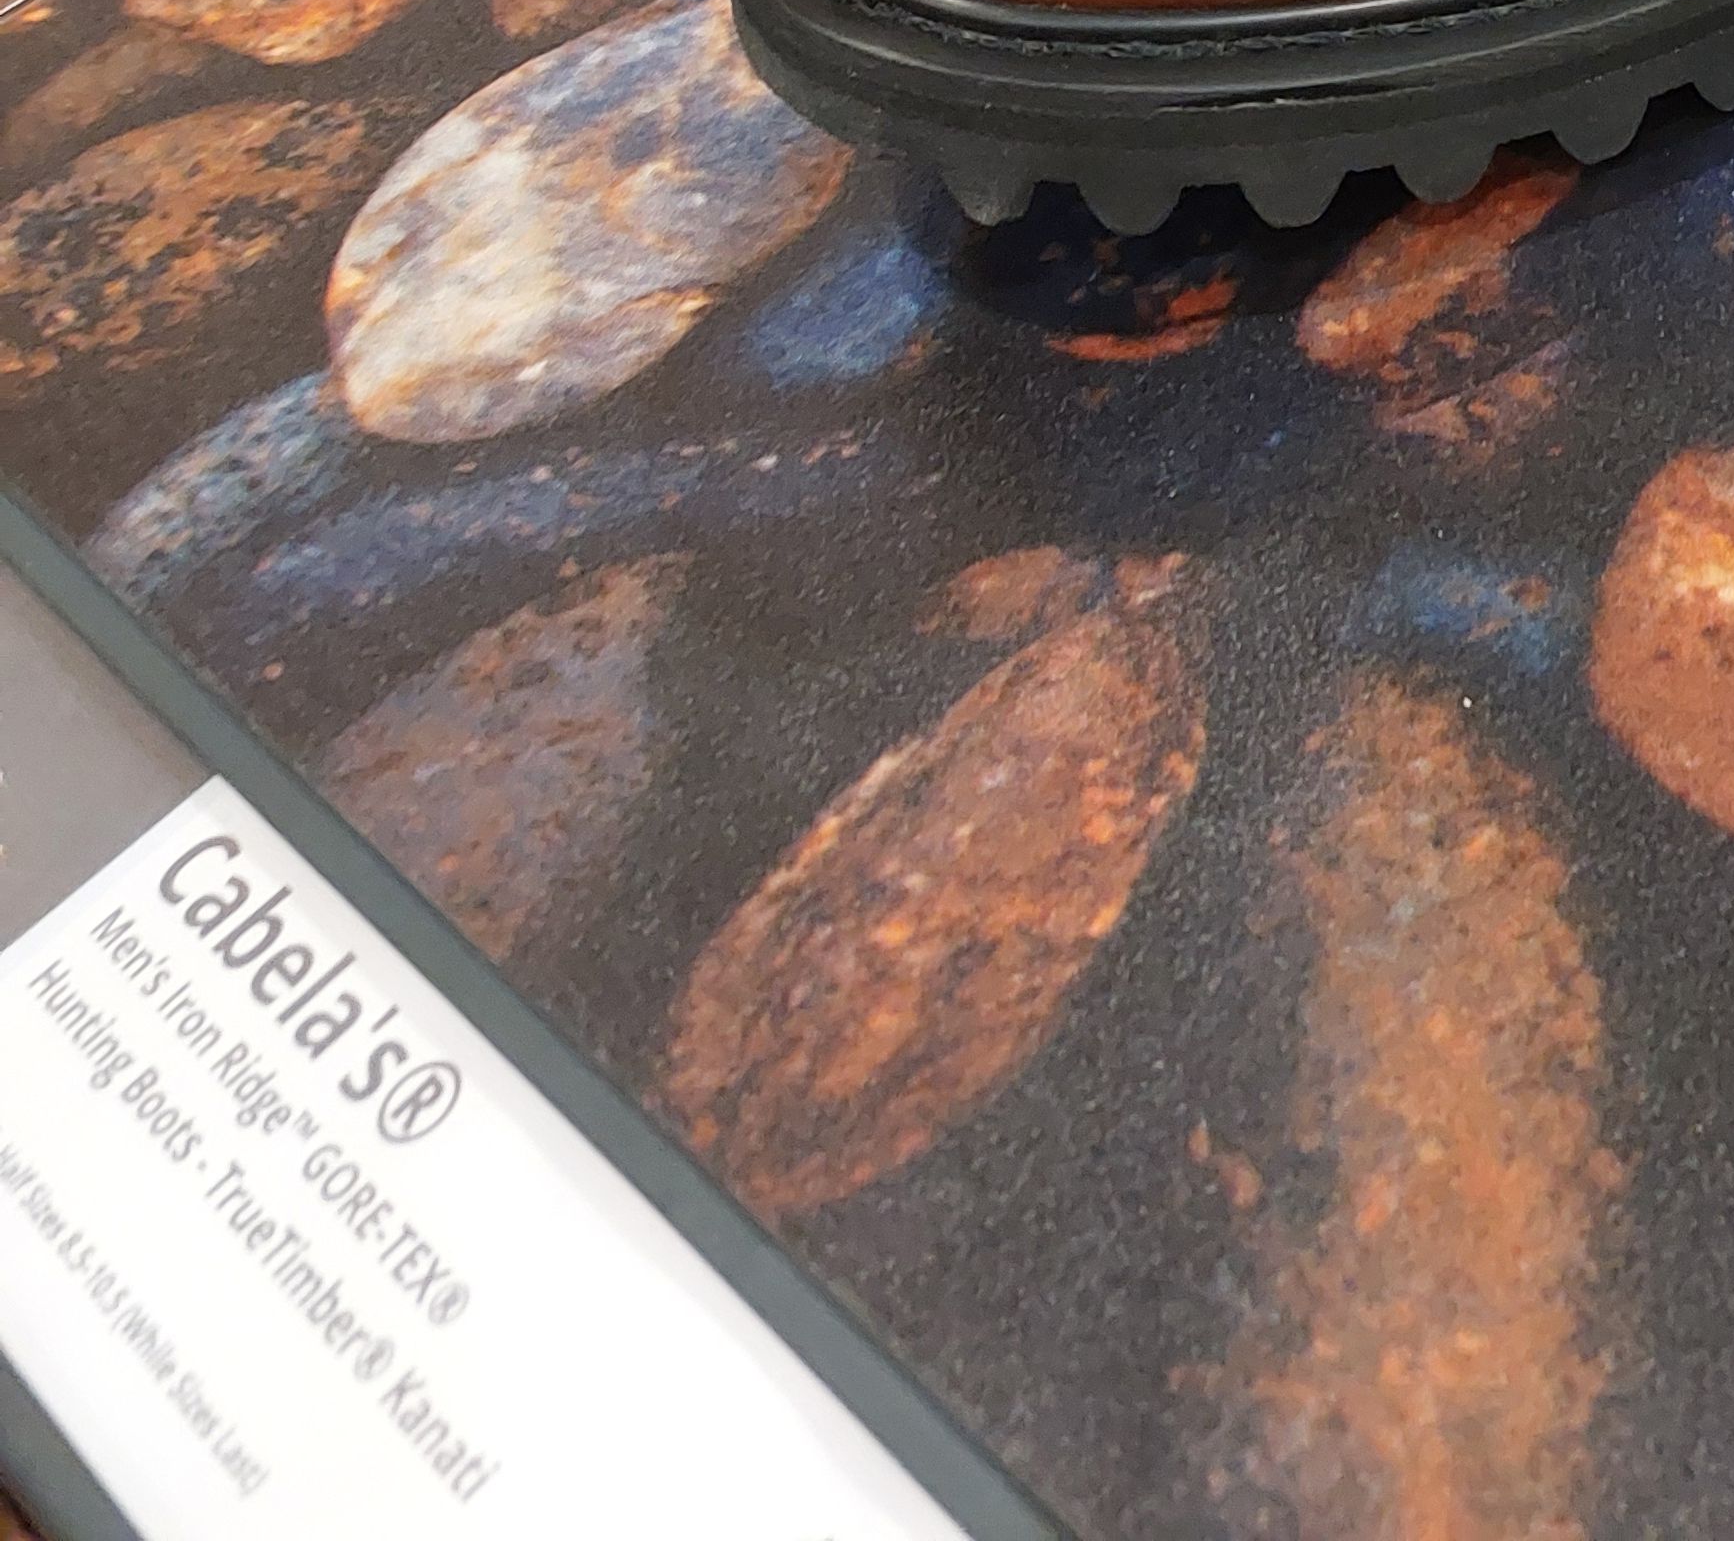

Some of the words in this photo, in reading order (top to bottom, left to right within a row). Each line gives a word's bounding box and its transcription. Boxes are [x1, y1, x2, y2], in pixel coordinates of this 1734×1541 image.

[91, 906, 171, 997] Men's
[156, 981, 223, 1058] Iron
[209, 1040, 321, 1143] Ridge™
[301, 1143, 470, 1328] GORE-TEX®
[158, 835, 462, 1145] Cabela's®
[16, 1182, 70, 1246] Sizes
[108, 1301, 179, 1386] (While
[165, 1369, 224, 1442] Sizes
[208, 1423, 272, 1503] Last)
[29, 959, 135, 1090] Hunting
[120, 1065, 202, 1163] Boots
[204, 1158, 396, 1383] TrueTimber®
[378, 1366, 501, 1504] Kanati
